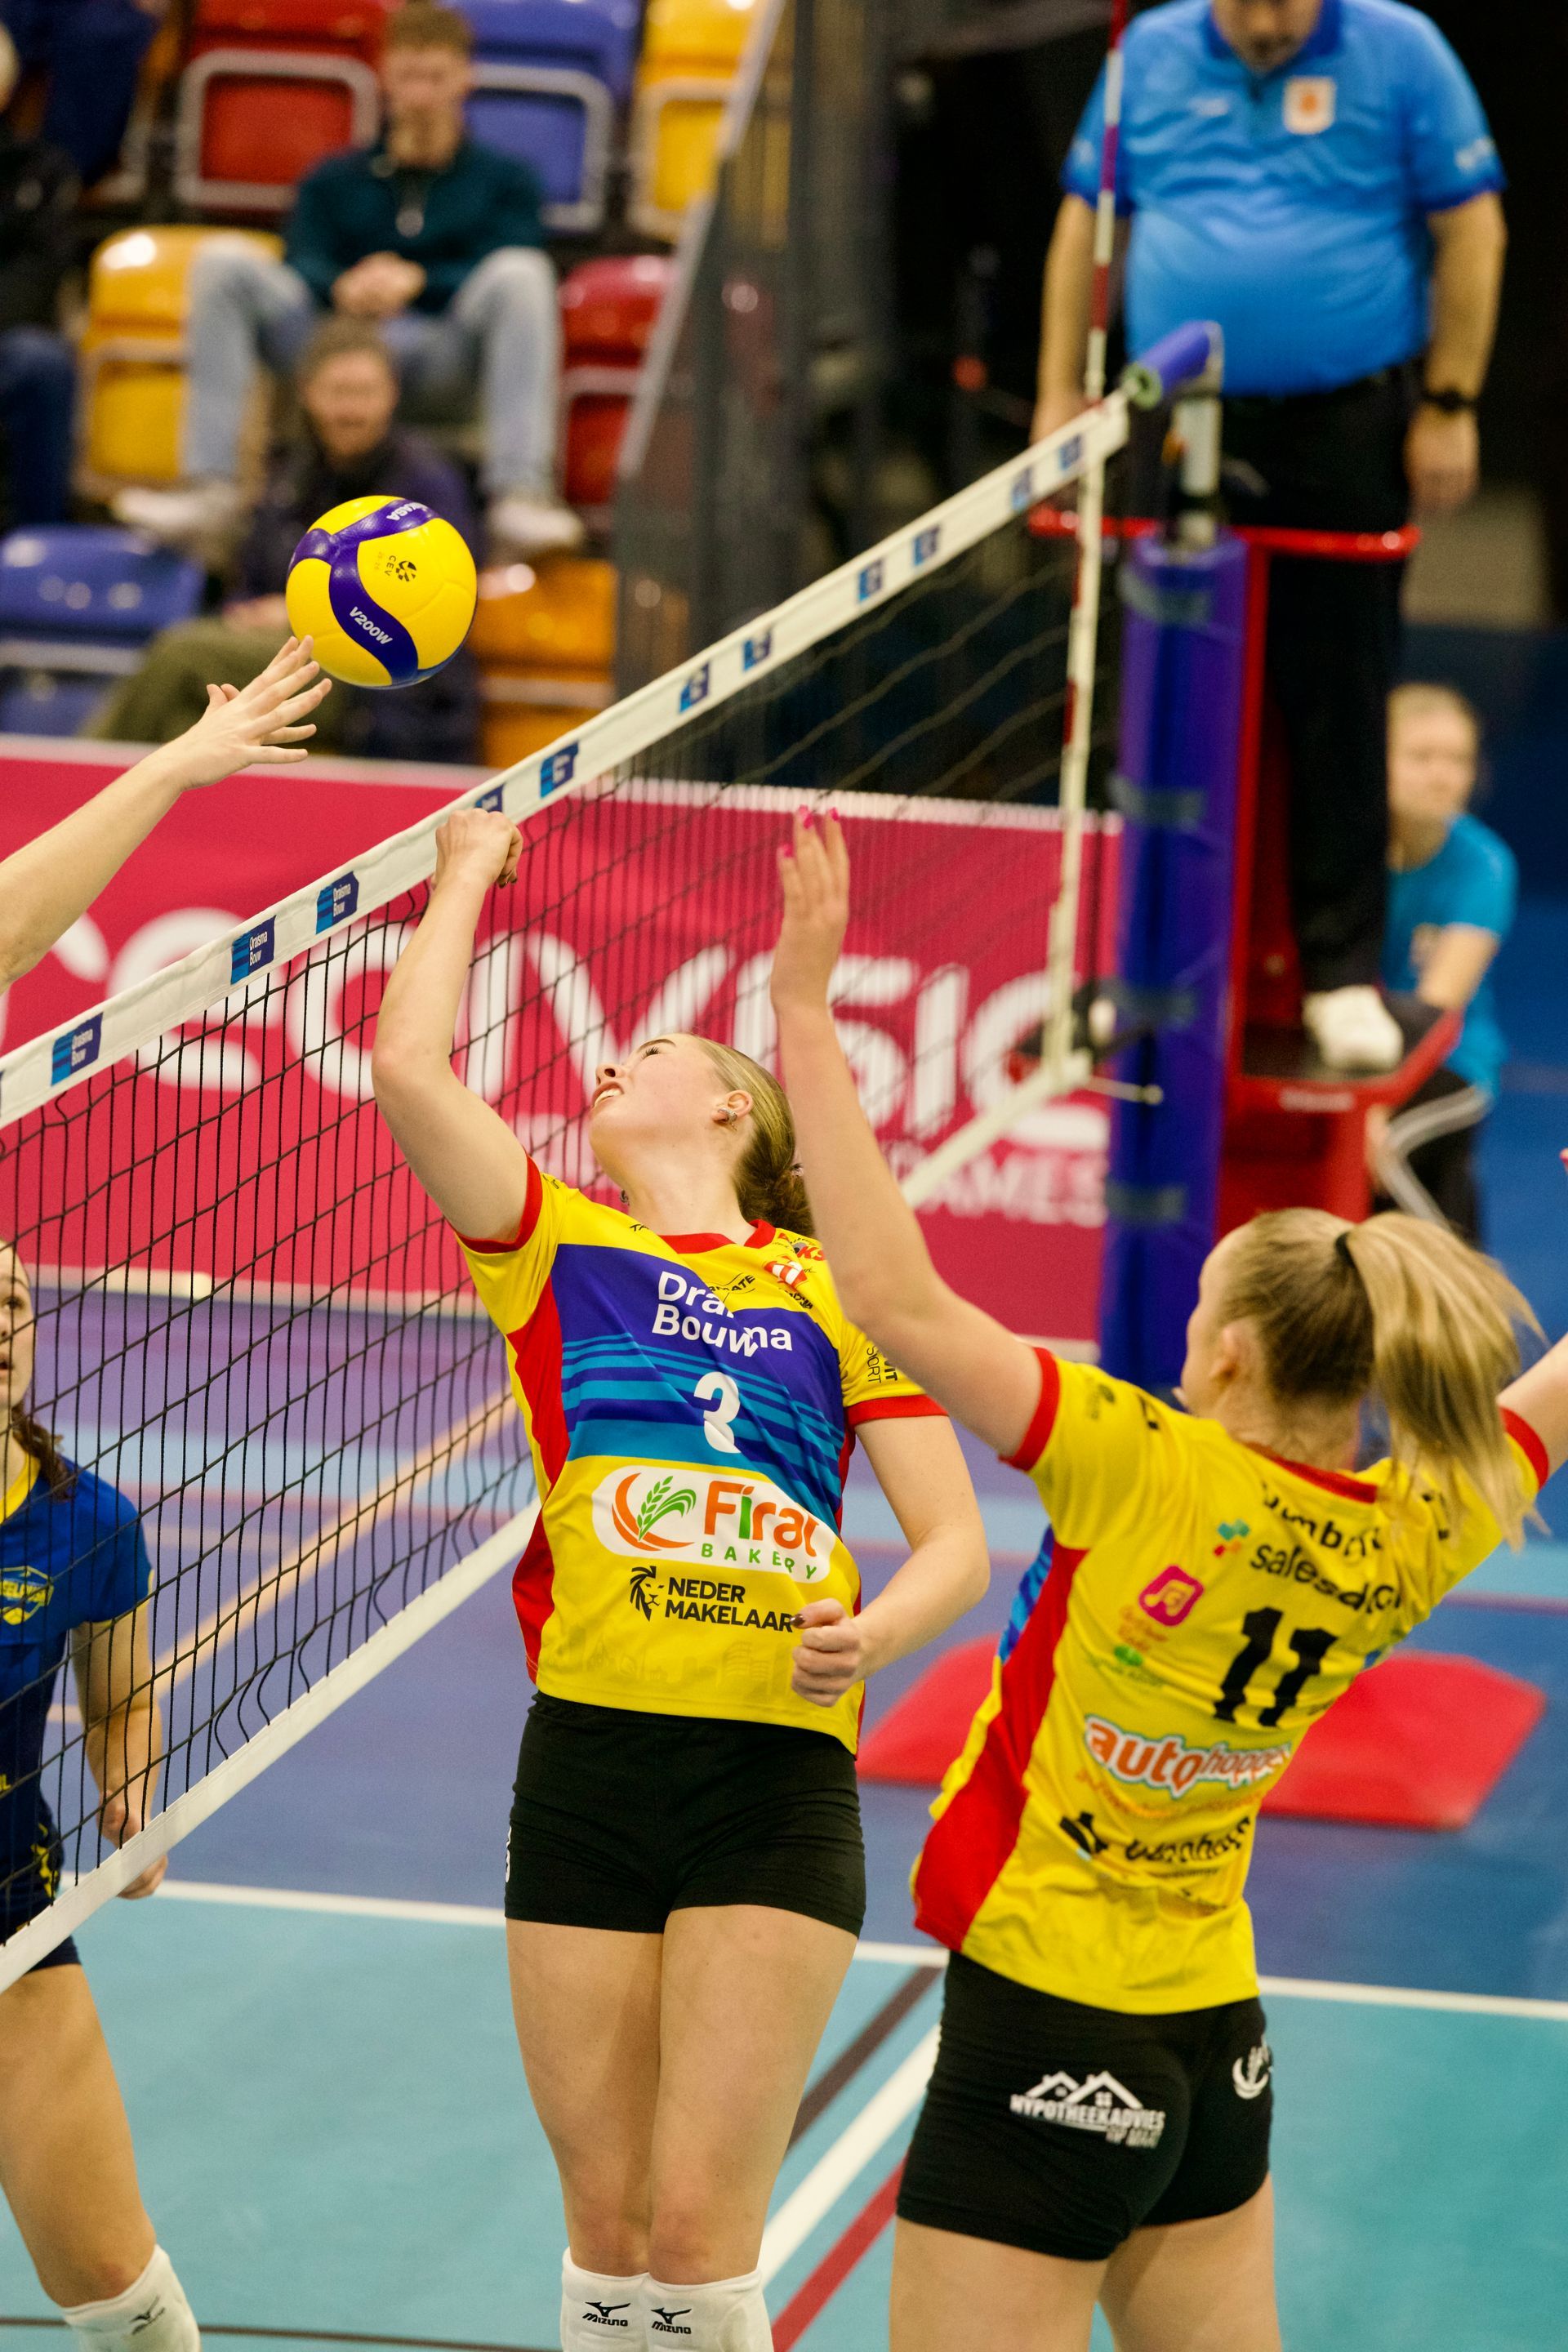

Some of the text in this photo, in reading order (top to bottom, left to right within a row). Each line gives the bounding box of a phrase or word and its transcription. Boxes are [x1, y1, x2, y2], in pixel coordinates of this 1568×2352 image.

[385, 555, 396, 576] CEV
[349, 606, 393, 644] V200W
[652, 1303, 759, 1357] Bouw
[701, 1543, 817, 1579] BAKERY
[668, 1577, 746, 1603] NEDER
[1214, 1606, 1339, 1728] 11
